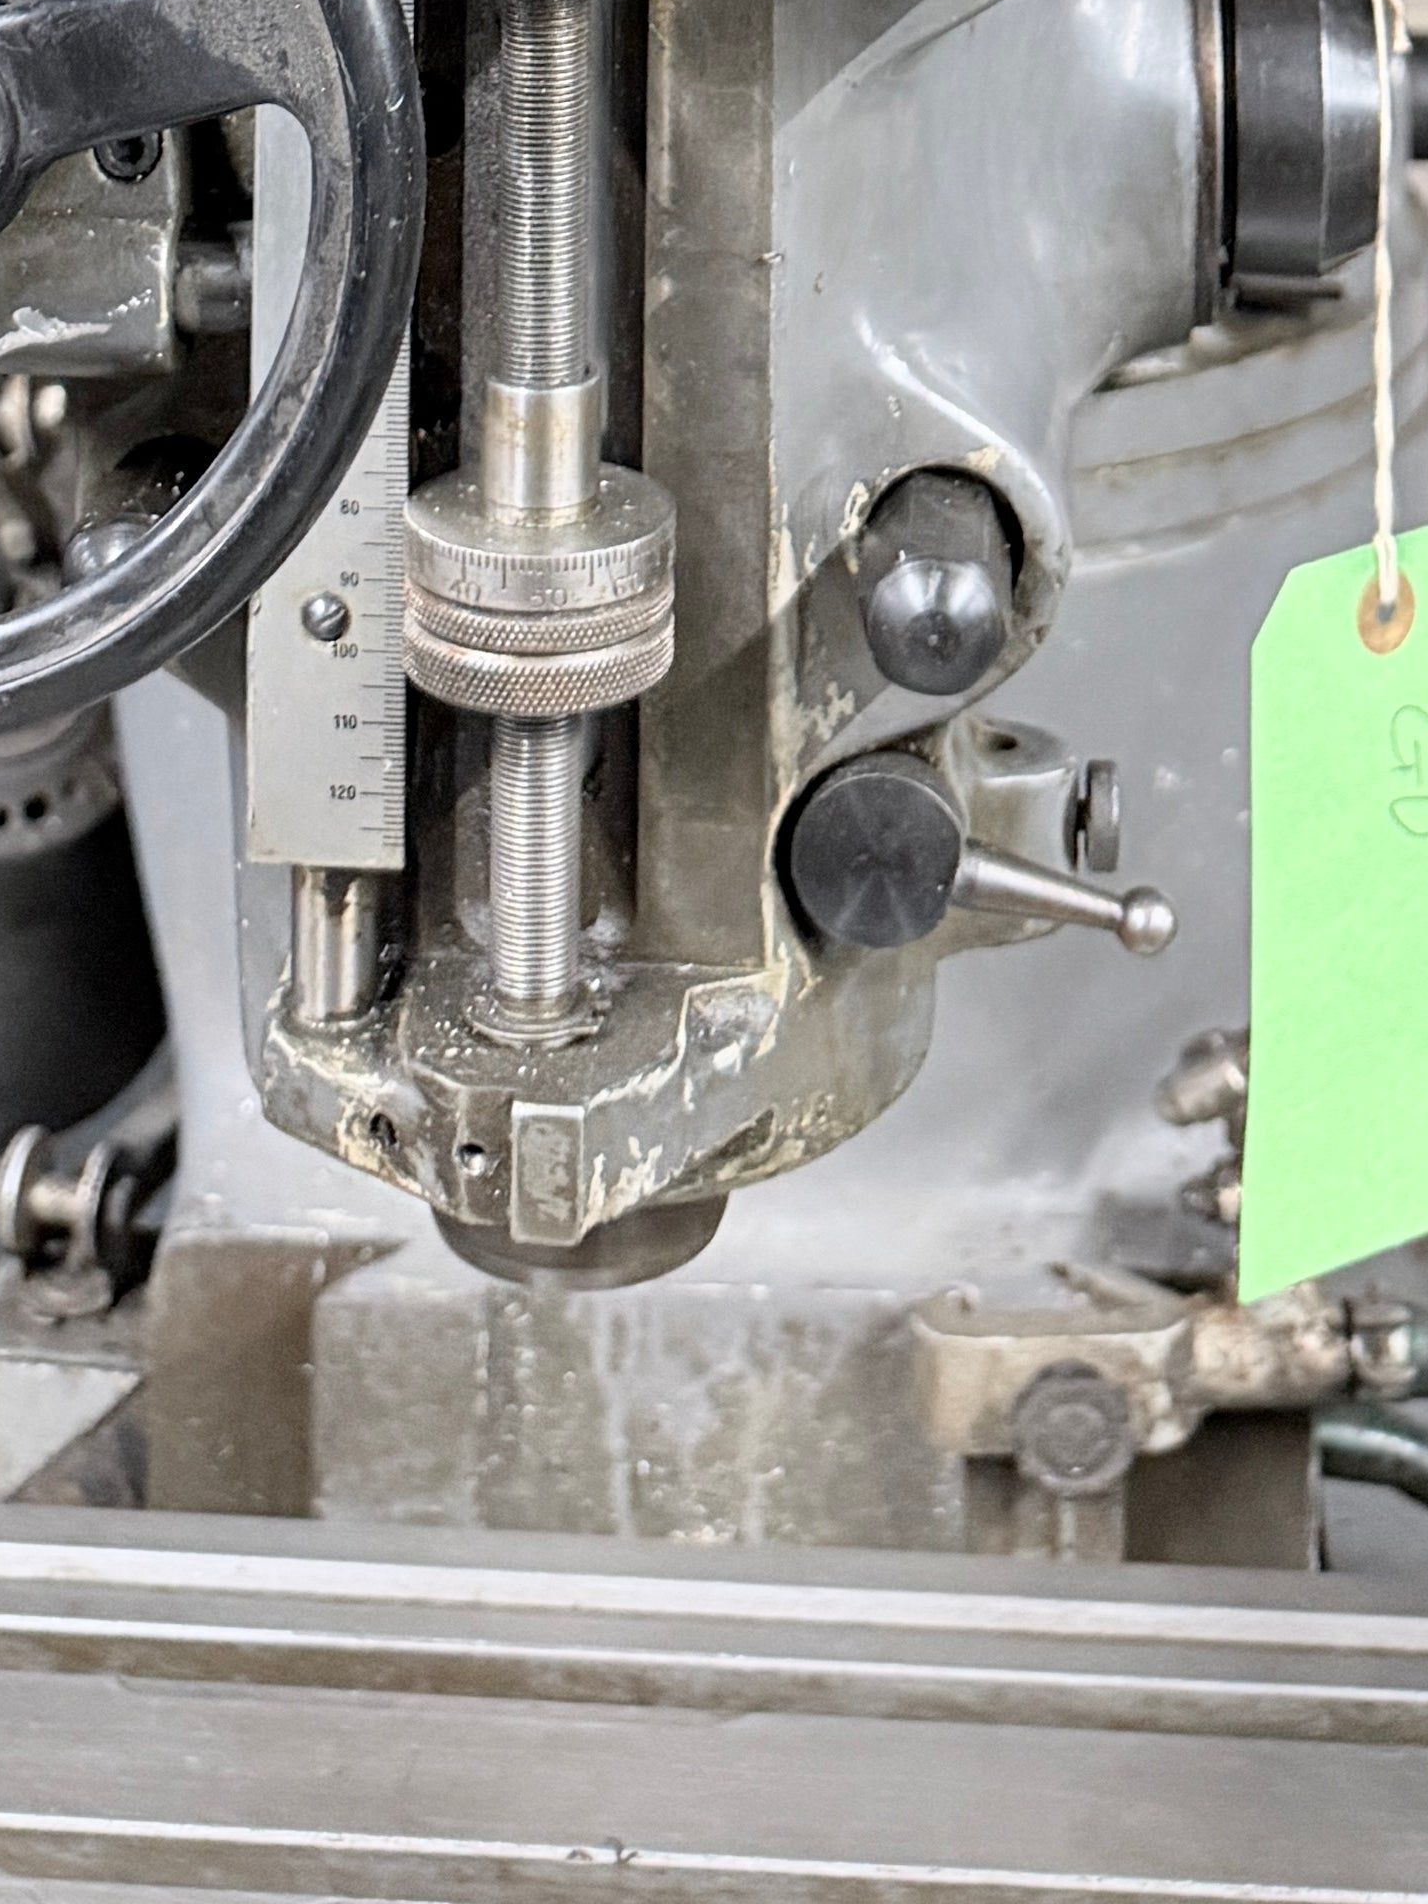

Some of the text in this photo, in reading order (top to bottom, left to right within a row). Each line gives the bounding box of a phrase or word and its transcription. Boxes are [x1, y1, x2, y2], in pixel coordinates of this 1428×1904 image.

[339, 498, 360, 516] 80
[339, 570, 360, 587] 90
[331, 642, 359, 658] 100
[333, 713, 358, 730] 110
[329, 783, 357, 800] 120
